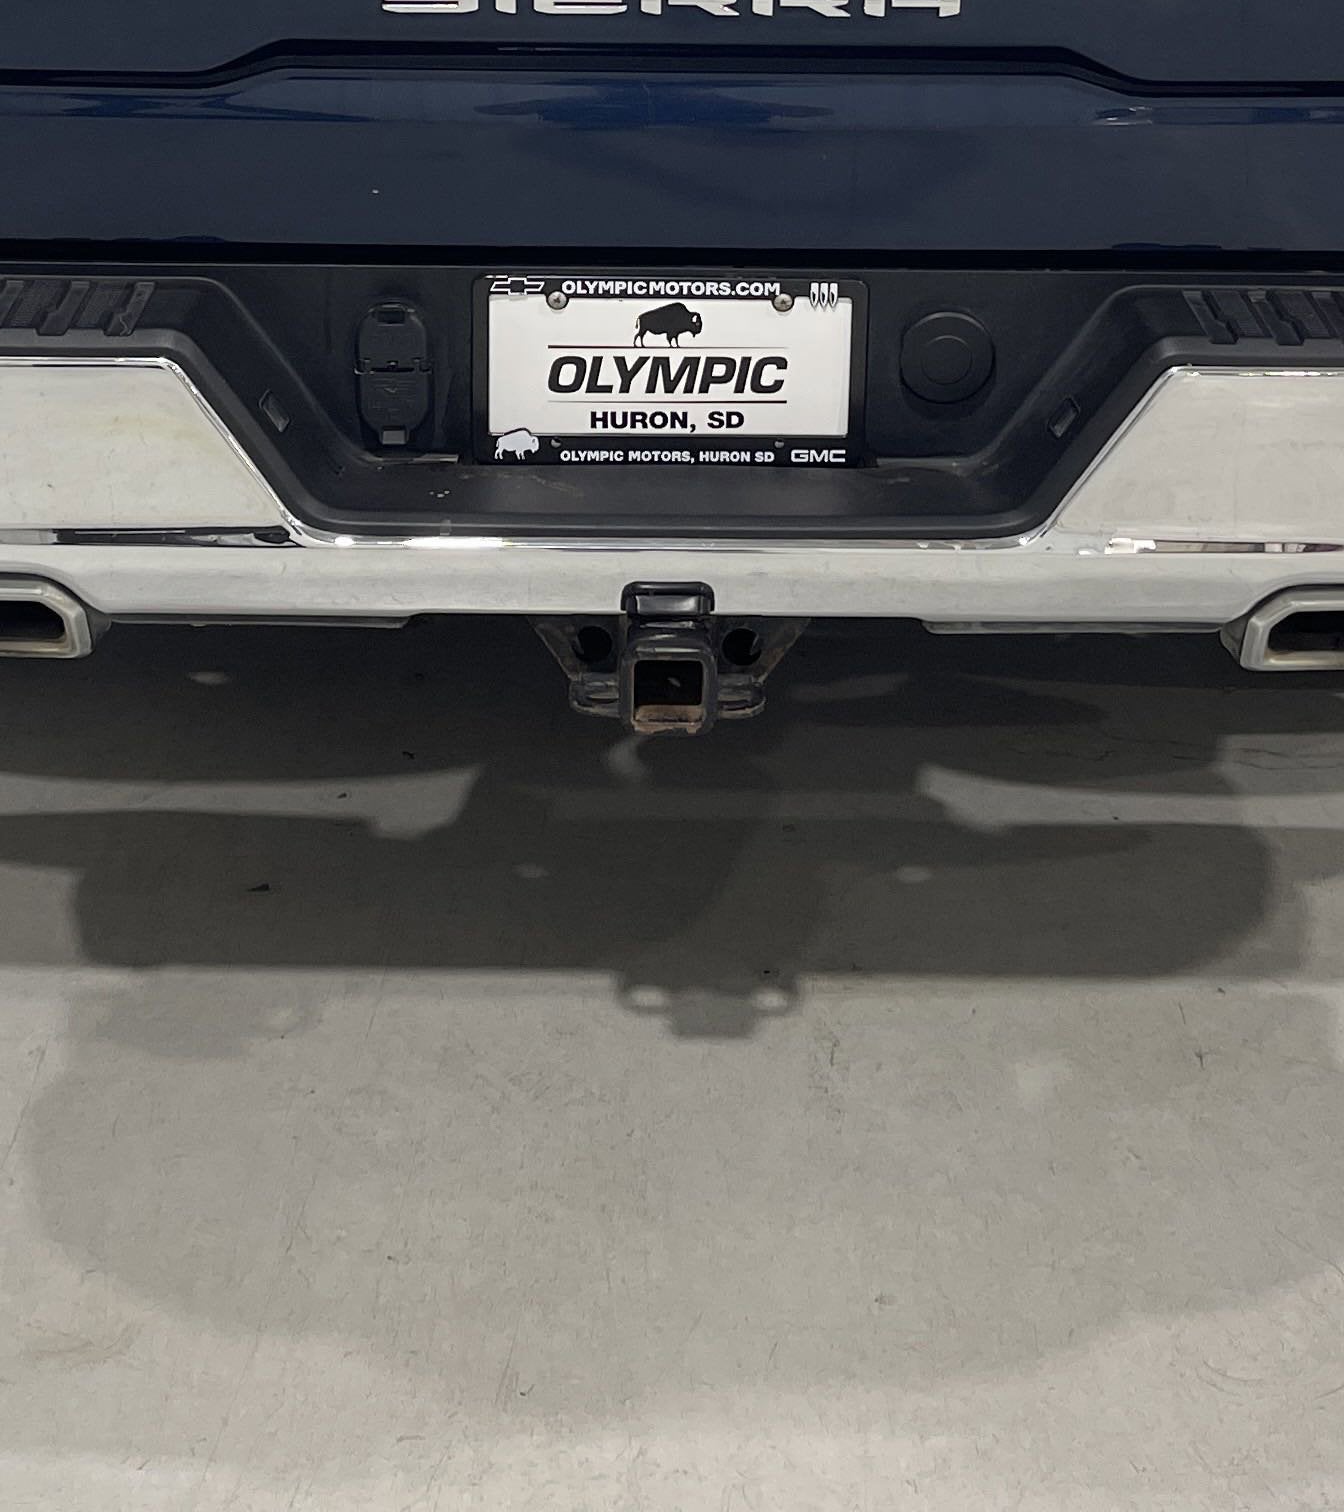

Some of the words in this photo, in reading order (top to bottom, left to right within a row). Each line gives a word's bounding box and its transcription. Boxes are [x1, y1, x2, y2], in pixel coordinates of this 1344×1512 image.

[548, 356, 788, 394] OLYMPIC
[590, 411, 696, 433] HURON,
[707, 411, 744, 429] SD
[560, 450, 624, 461] OLYMPIC
[628, 451, 695, 464] MOTORS,
[699, 451, 750, 462] HURON
[754, 451, 775, 462] SD
[791, 449, 846, 462] GMC
